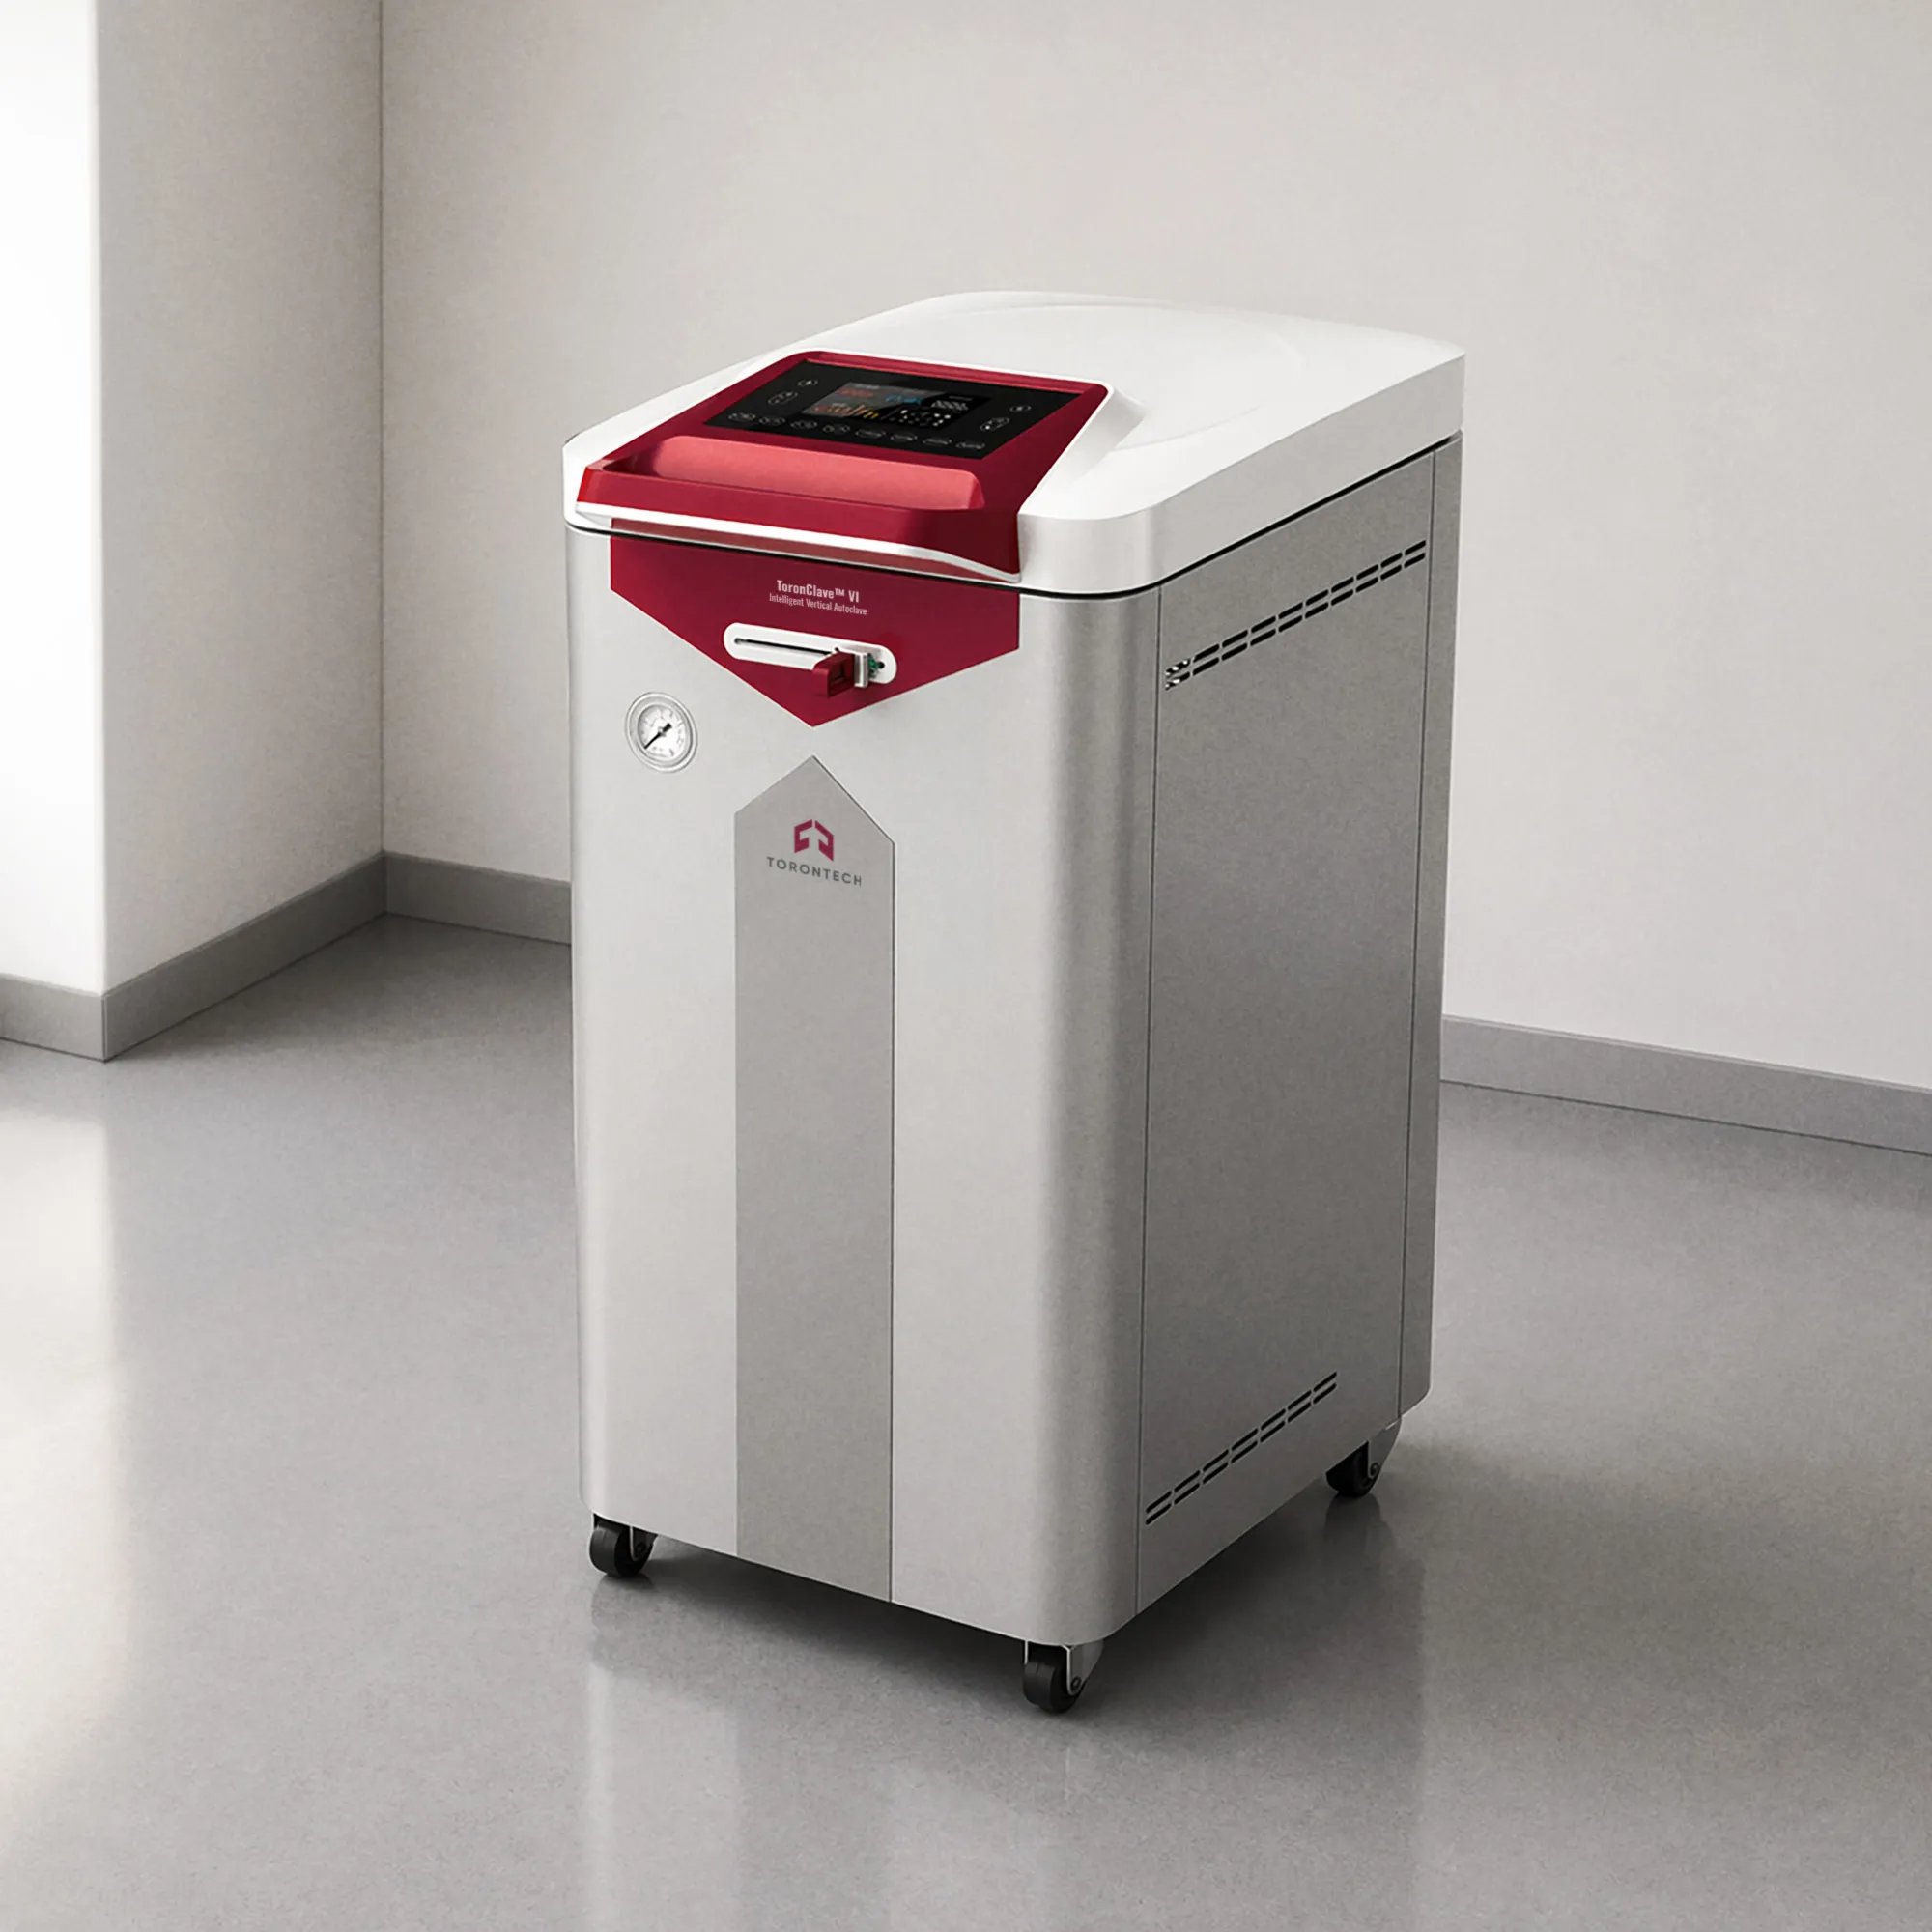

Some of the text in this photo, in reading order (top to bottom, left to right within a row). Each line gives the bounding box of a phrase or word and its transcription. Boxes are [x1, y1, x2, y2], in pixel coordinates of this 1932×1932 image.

[769, 592, 867, 615] Intelligent Vertical Autoclave
[848, 589, 860, 603] VI
[766, 856, 863, 887] TORONTECH
